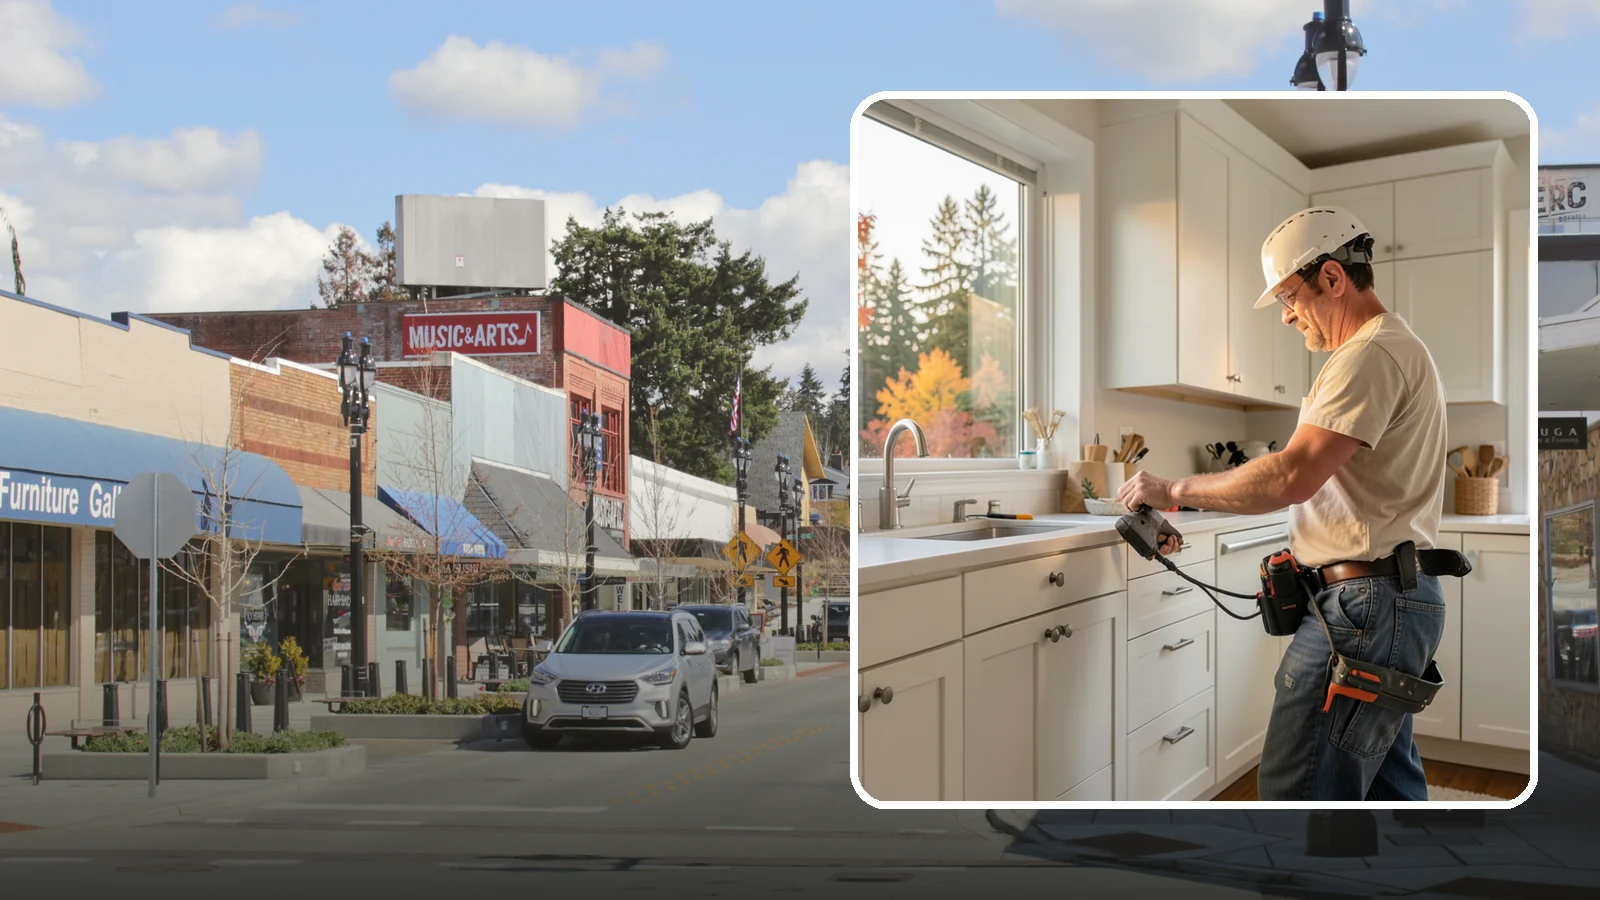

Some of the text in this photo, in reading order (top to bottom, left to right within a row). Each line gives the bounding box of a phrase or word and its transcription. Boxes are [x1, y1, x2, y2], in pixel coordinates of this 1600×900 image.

[408, 323, 520, 349] MUSIC&ARTS
[0, 471, 122, 519] Furniture Gal
